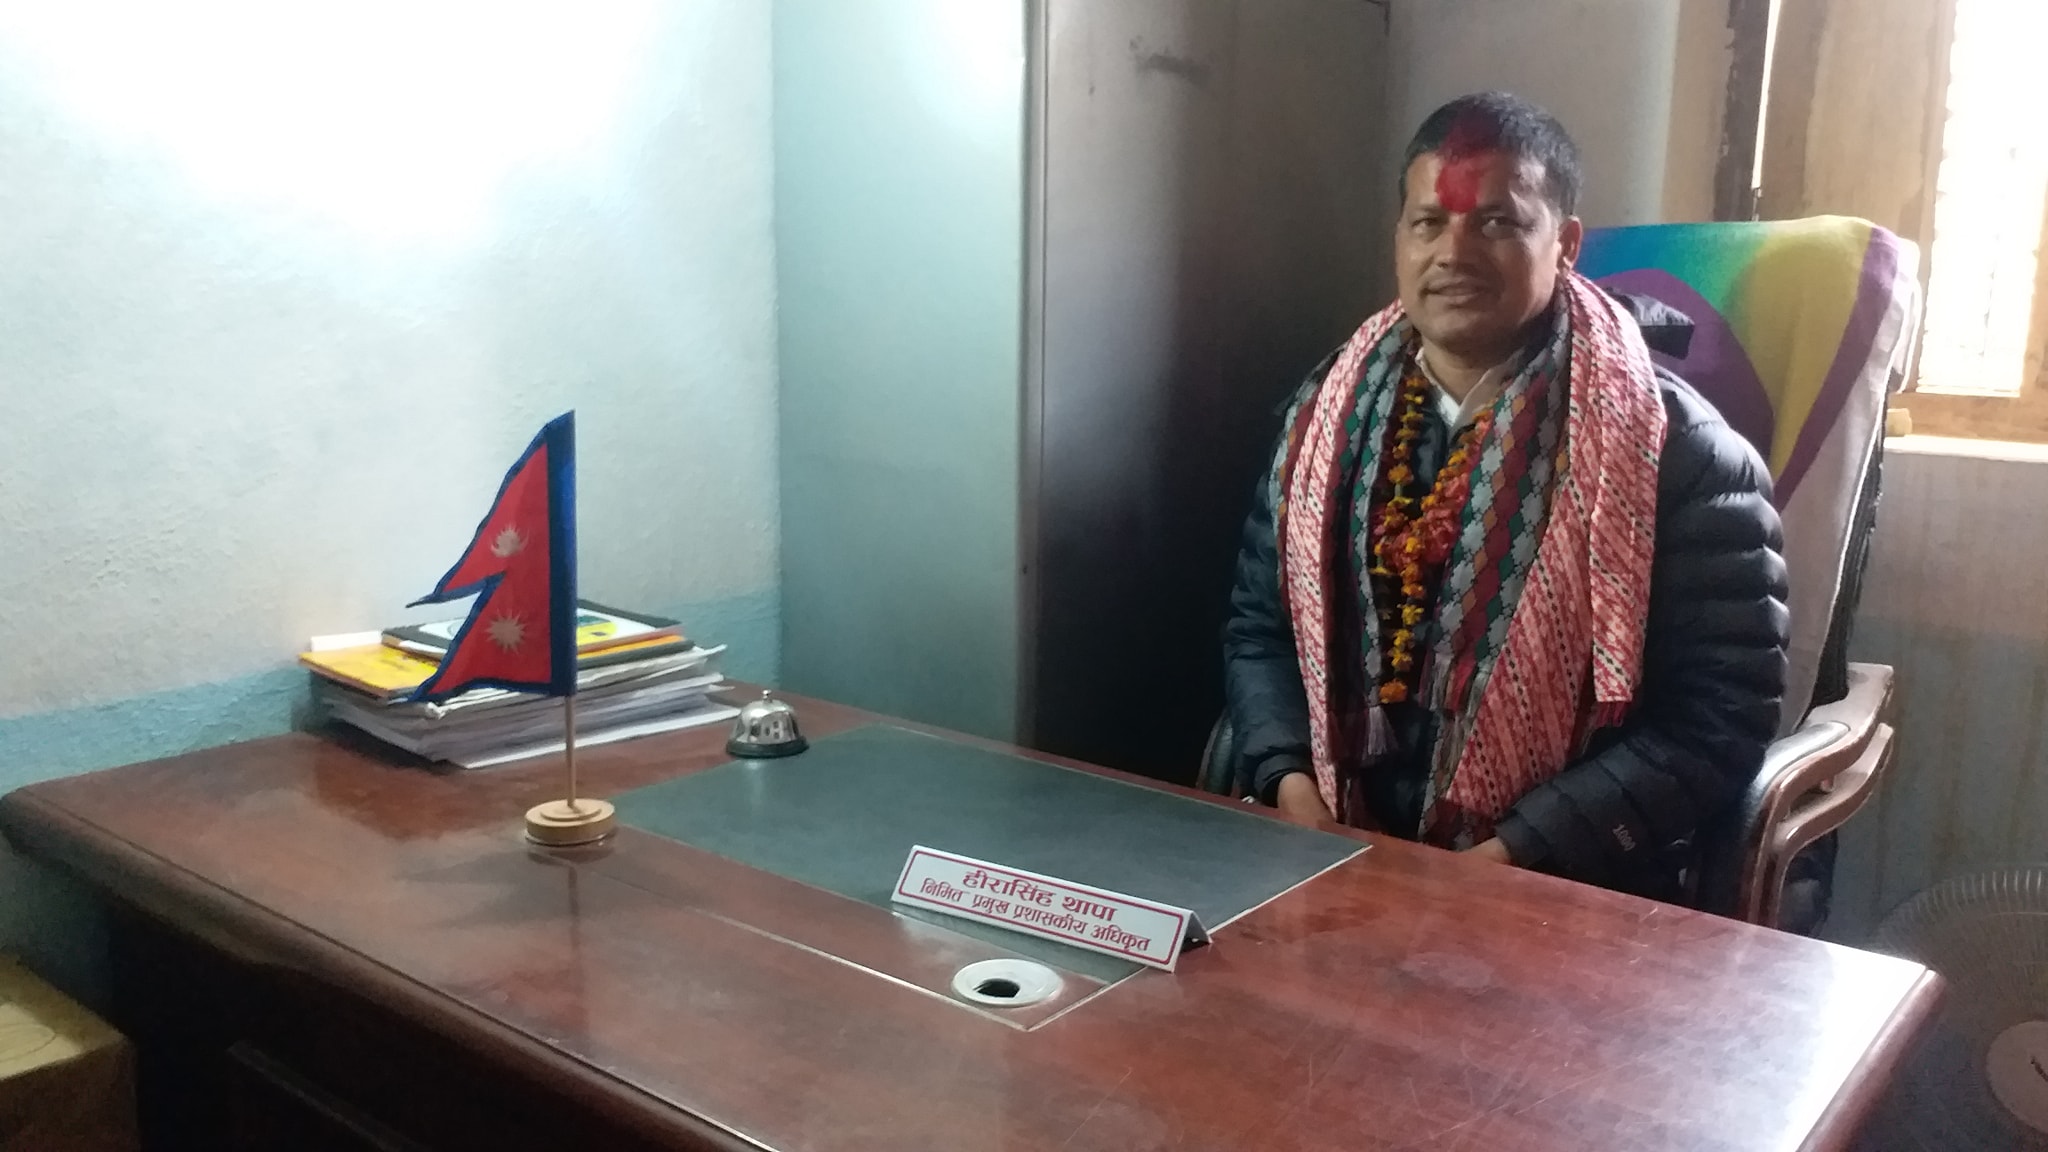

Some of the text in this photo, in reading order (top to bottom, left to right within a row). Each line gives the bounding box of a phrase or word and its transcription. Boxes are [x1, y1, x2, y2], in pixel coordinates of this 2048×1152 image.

[963, 870, 1118, 921] हीरासिंह थापा
[972, 893, 1011, 913] प्रमुख
[1013, 904, 1088, 934] प्रशासकीय
[1091, 924, 1152, 951] अधिकृत
